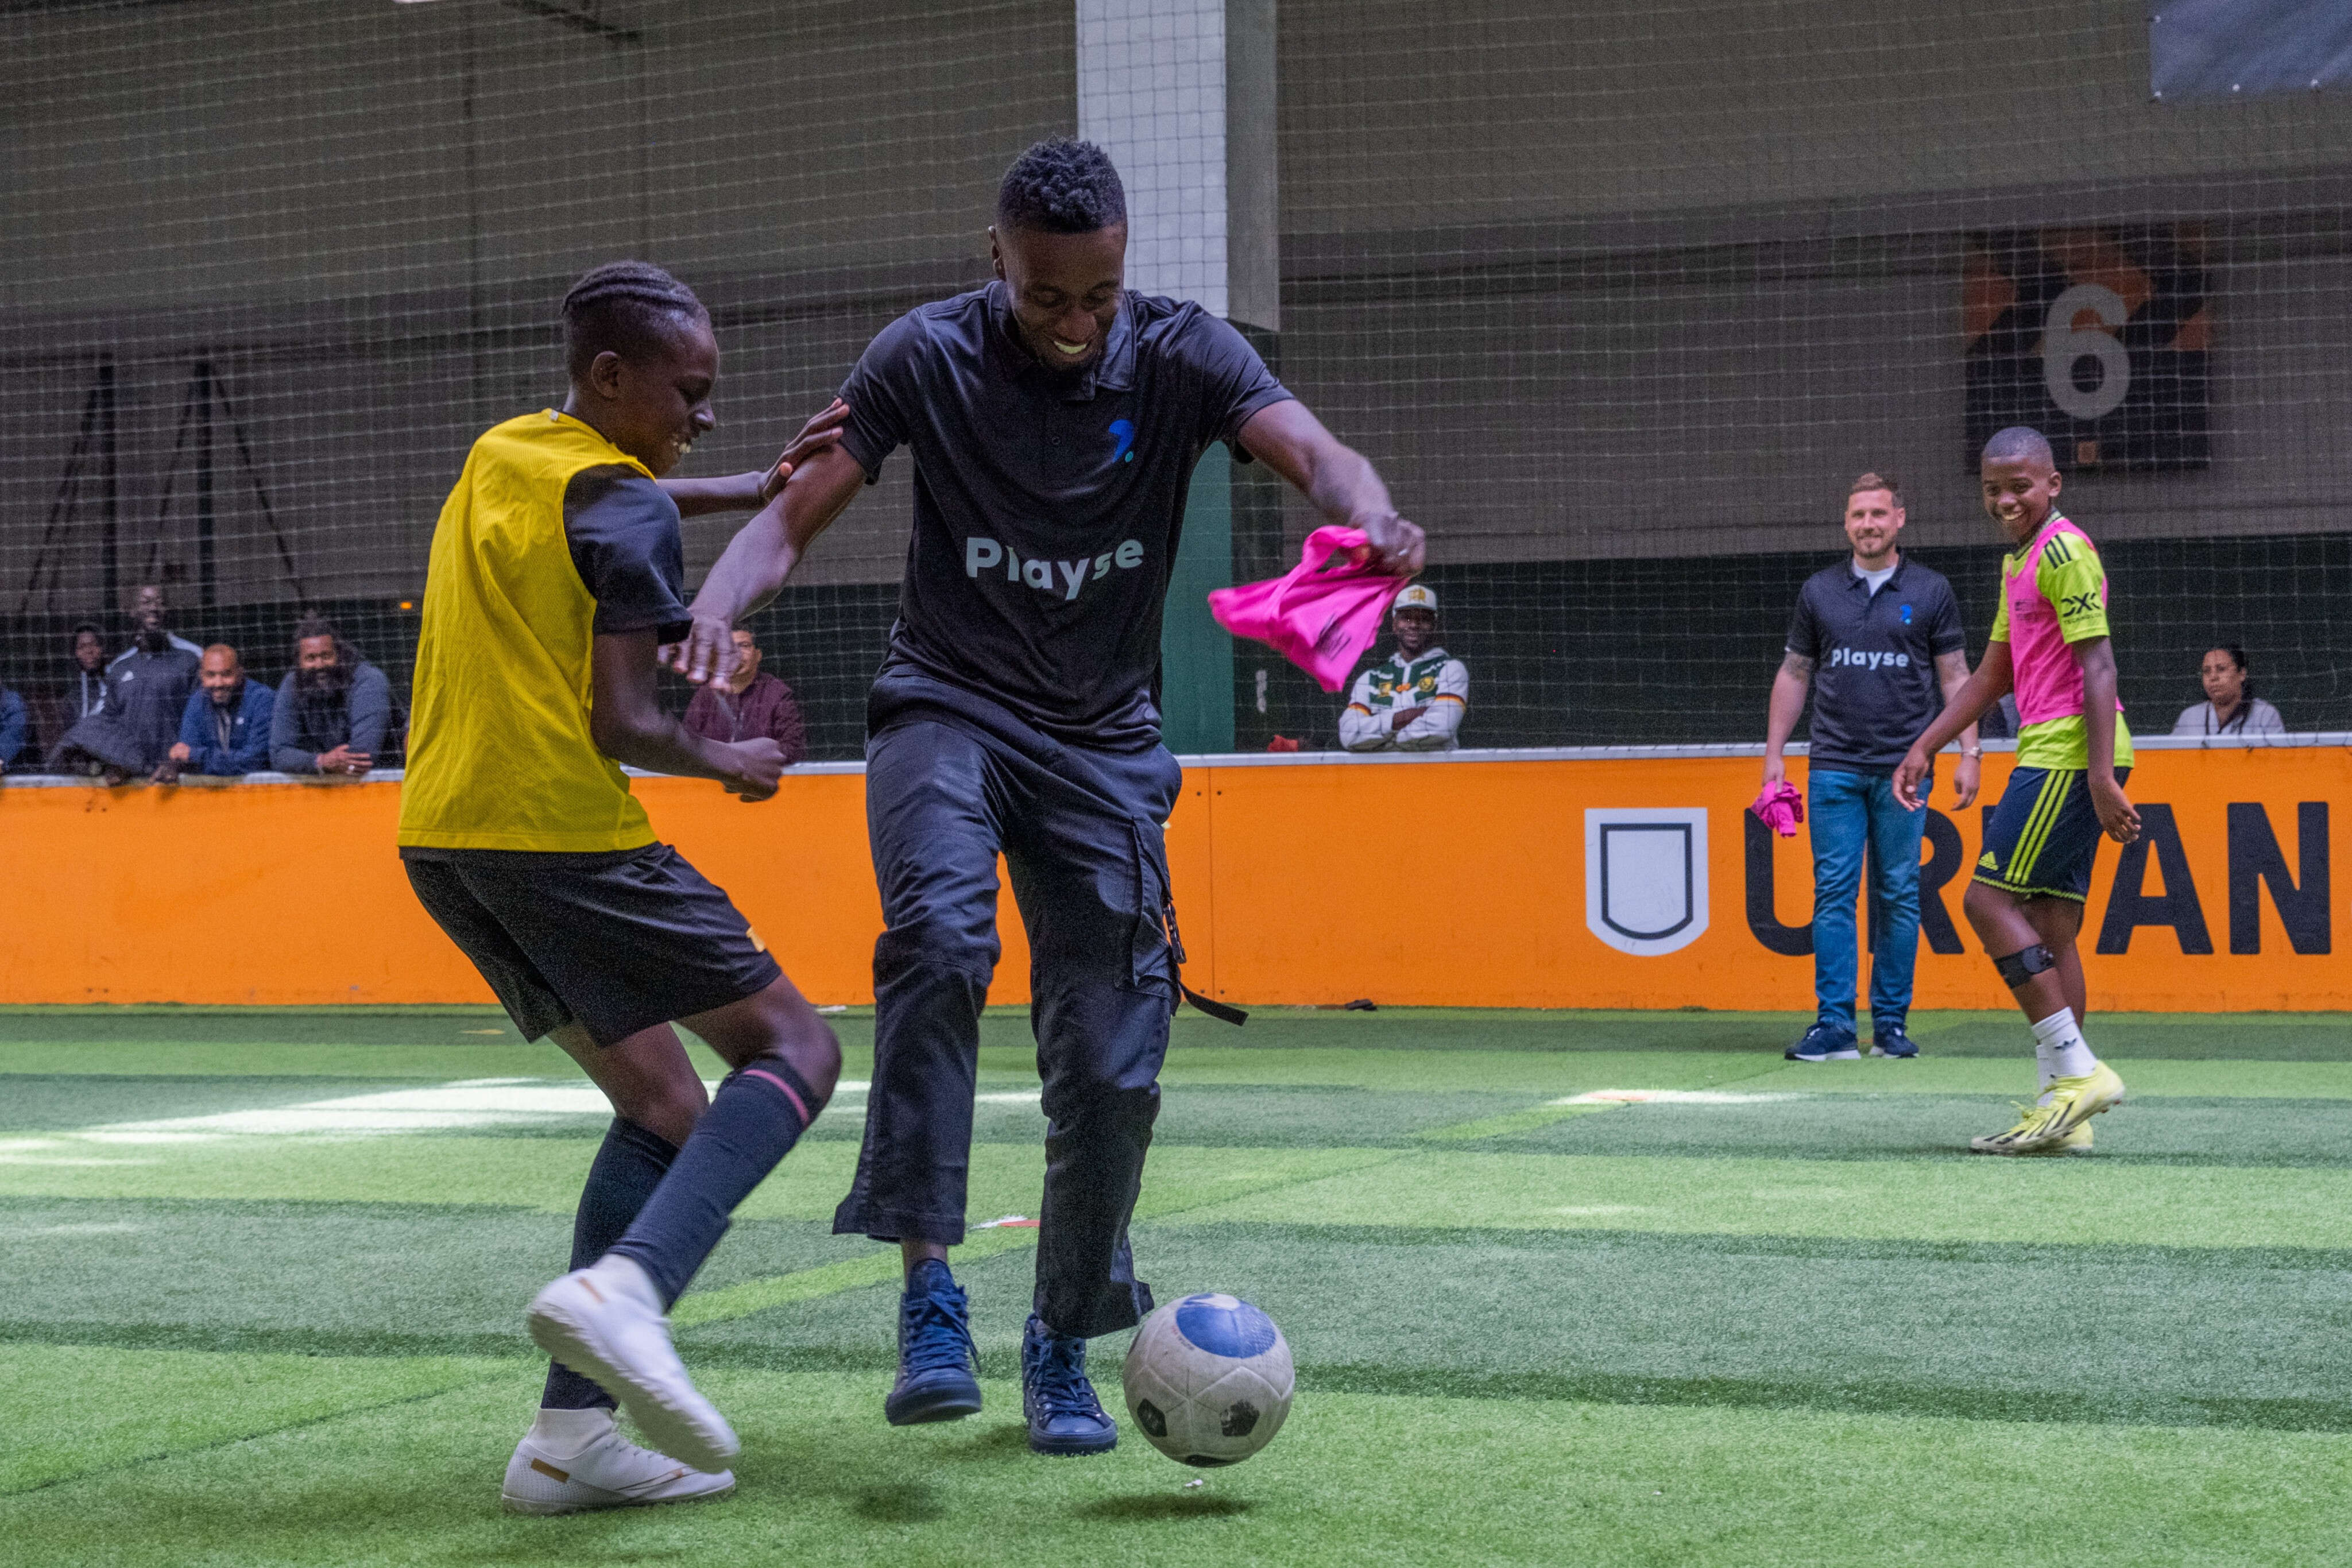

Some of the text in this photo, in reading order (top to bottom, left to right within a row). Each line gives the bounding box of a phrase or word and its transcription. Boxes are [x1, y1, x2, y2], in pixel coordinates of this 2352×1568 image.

[2043, 284, 2131, 420] 6
[966, 537, 1144, 601] Playse
[1831, 647, 1909, 671] Playse
[1744, 802, 2332, 956] URAN
